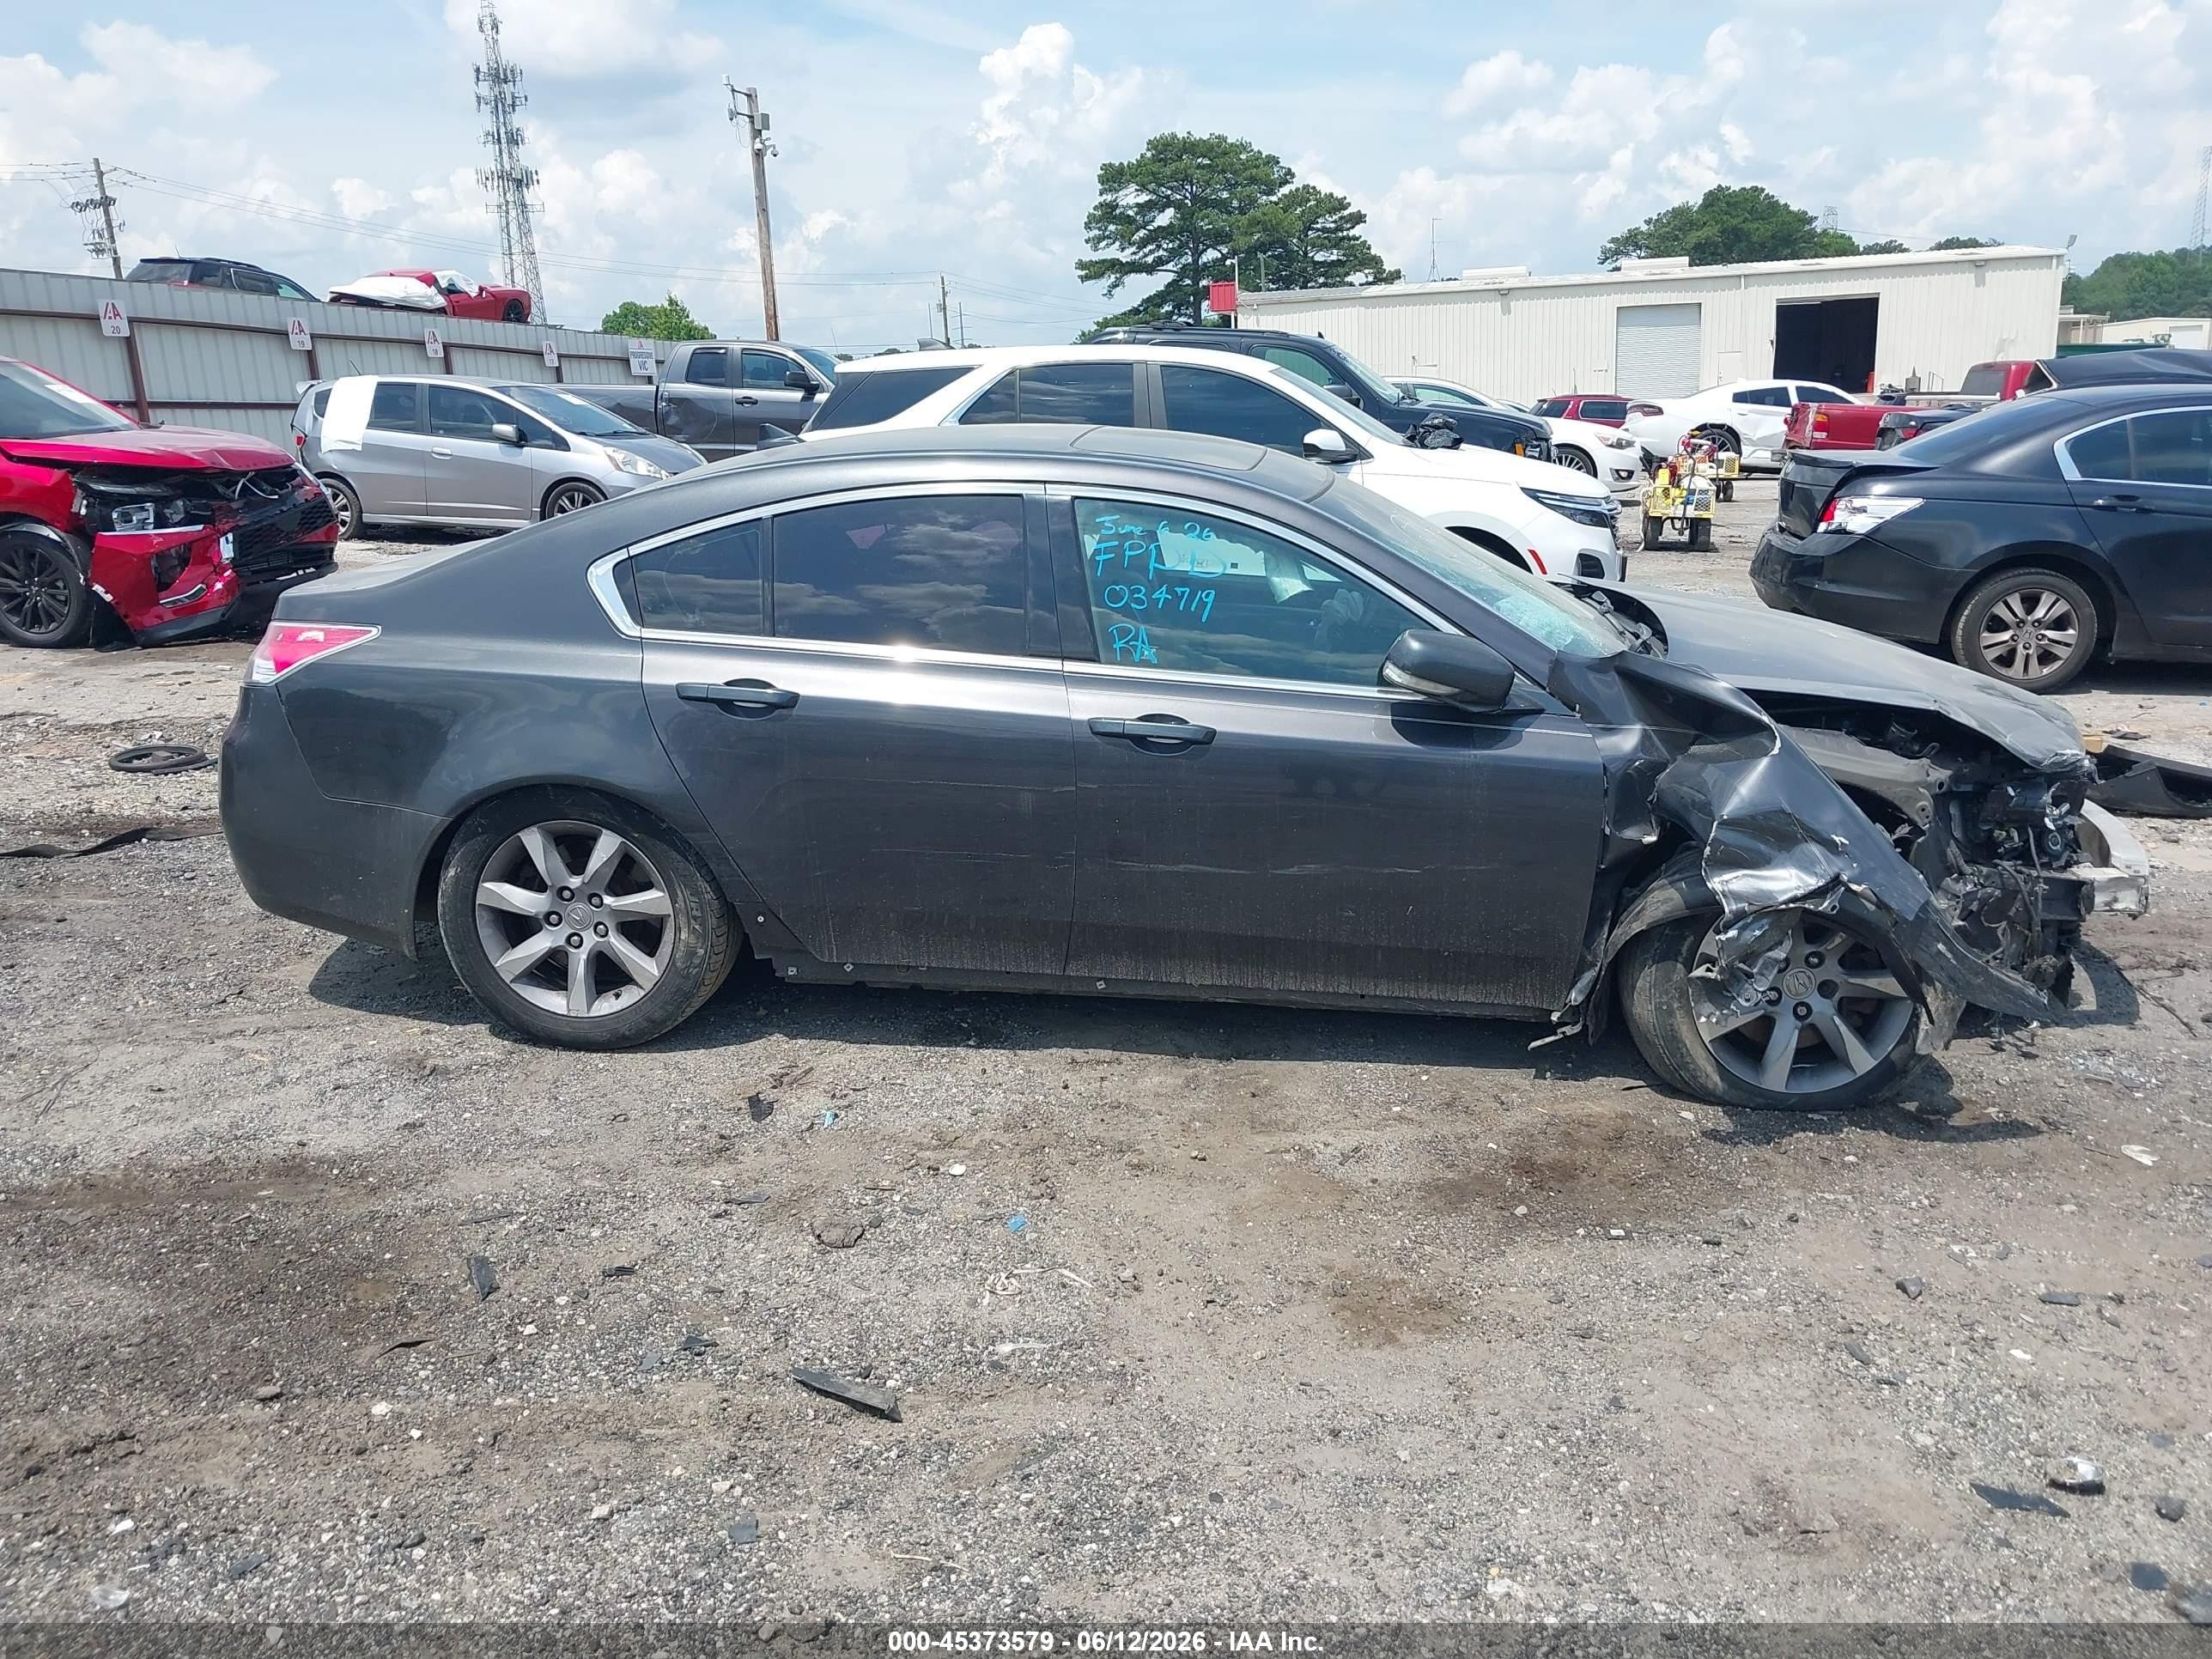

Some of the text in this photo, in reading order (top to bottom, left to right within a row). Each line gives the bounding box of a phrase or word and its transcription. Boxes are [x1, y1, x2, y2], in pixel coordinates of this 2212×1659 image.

[110, 325, 121, 335] 20
[297, 340, 306, 349] 19
[637, 360, 649, 372] VIC
[1104, 584, 1216, 623] 034719
